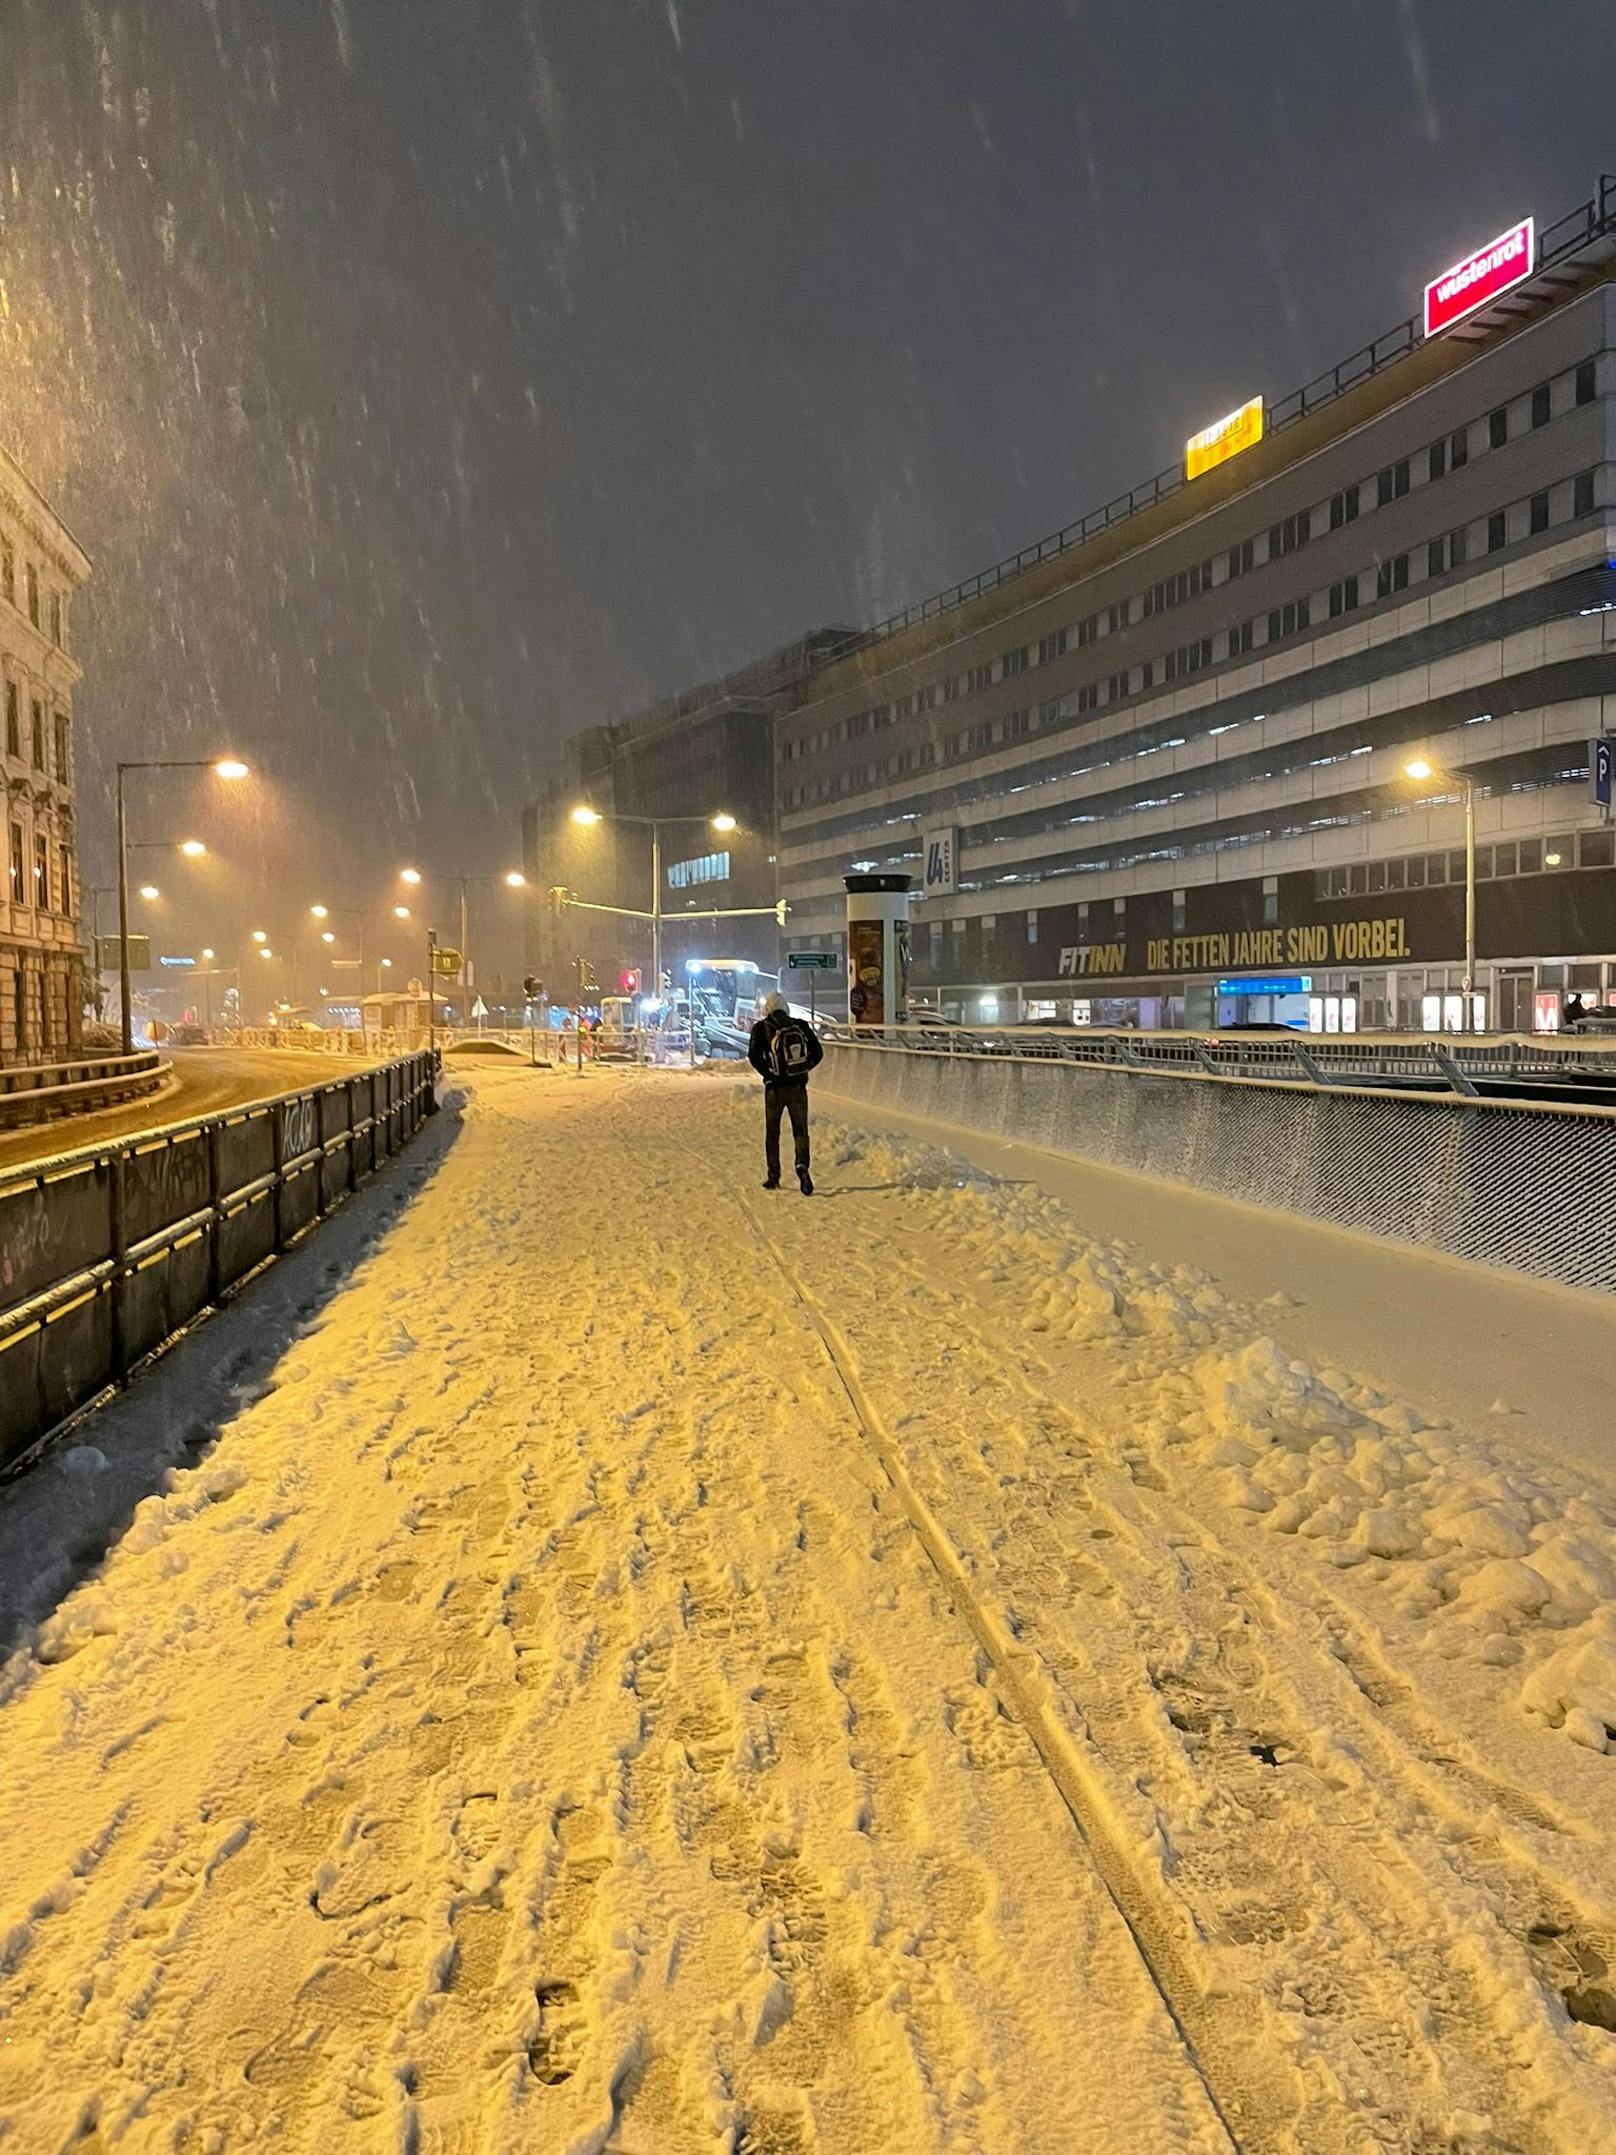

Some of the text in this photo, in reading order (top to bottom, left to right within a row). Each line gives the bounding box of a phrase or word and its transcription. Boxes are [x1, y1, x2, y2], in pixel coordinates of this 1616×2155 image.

[1599, 758, 1607, 782] P
[1058, 943, 1127, 975] FITINN
[1147, 917, 1411, 970] DIE FETTEN JAHRE SIND VORBEI.
